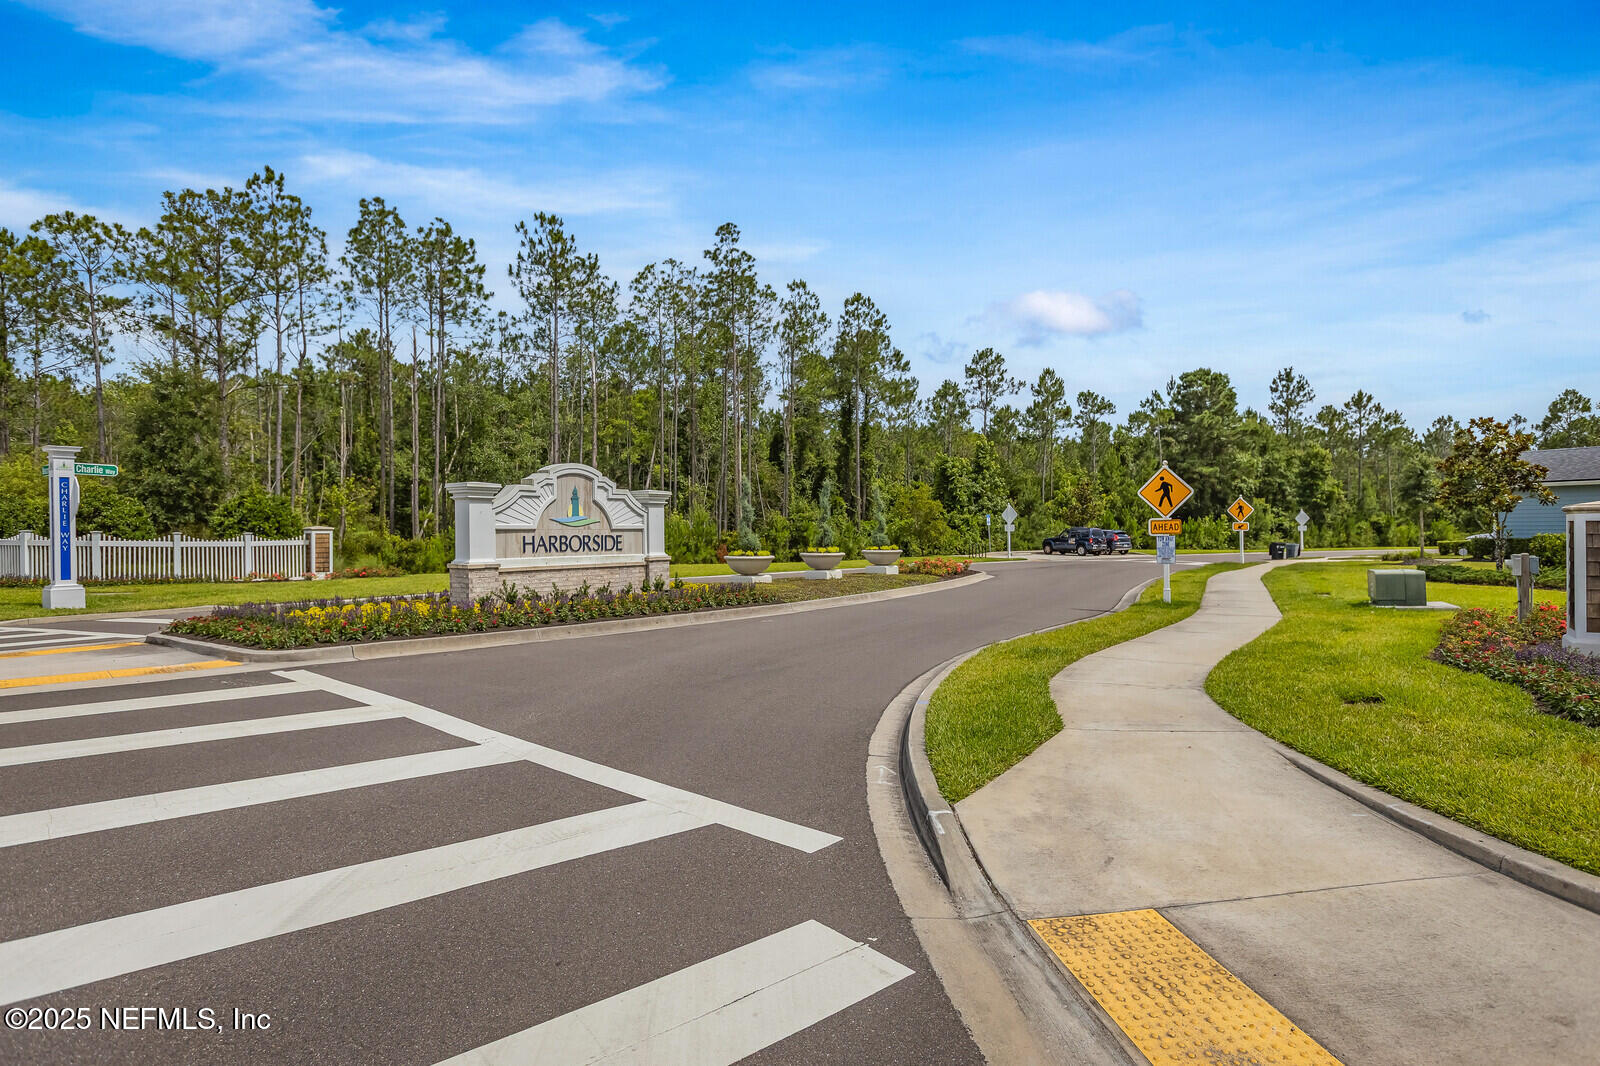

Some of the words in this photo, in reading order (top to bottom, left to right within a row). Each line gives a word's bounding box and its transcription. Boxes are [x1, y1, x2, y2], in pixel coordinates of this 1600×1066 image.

[76, 464, 104, 474] Charlie
[60, 481, 68, 527] CHARLIE
[1153, 523, 1180, 531] AHEAD
[60, 532, 70, 551] WAY
[522, 534, 623, 553] HARBORSIDE
